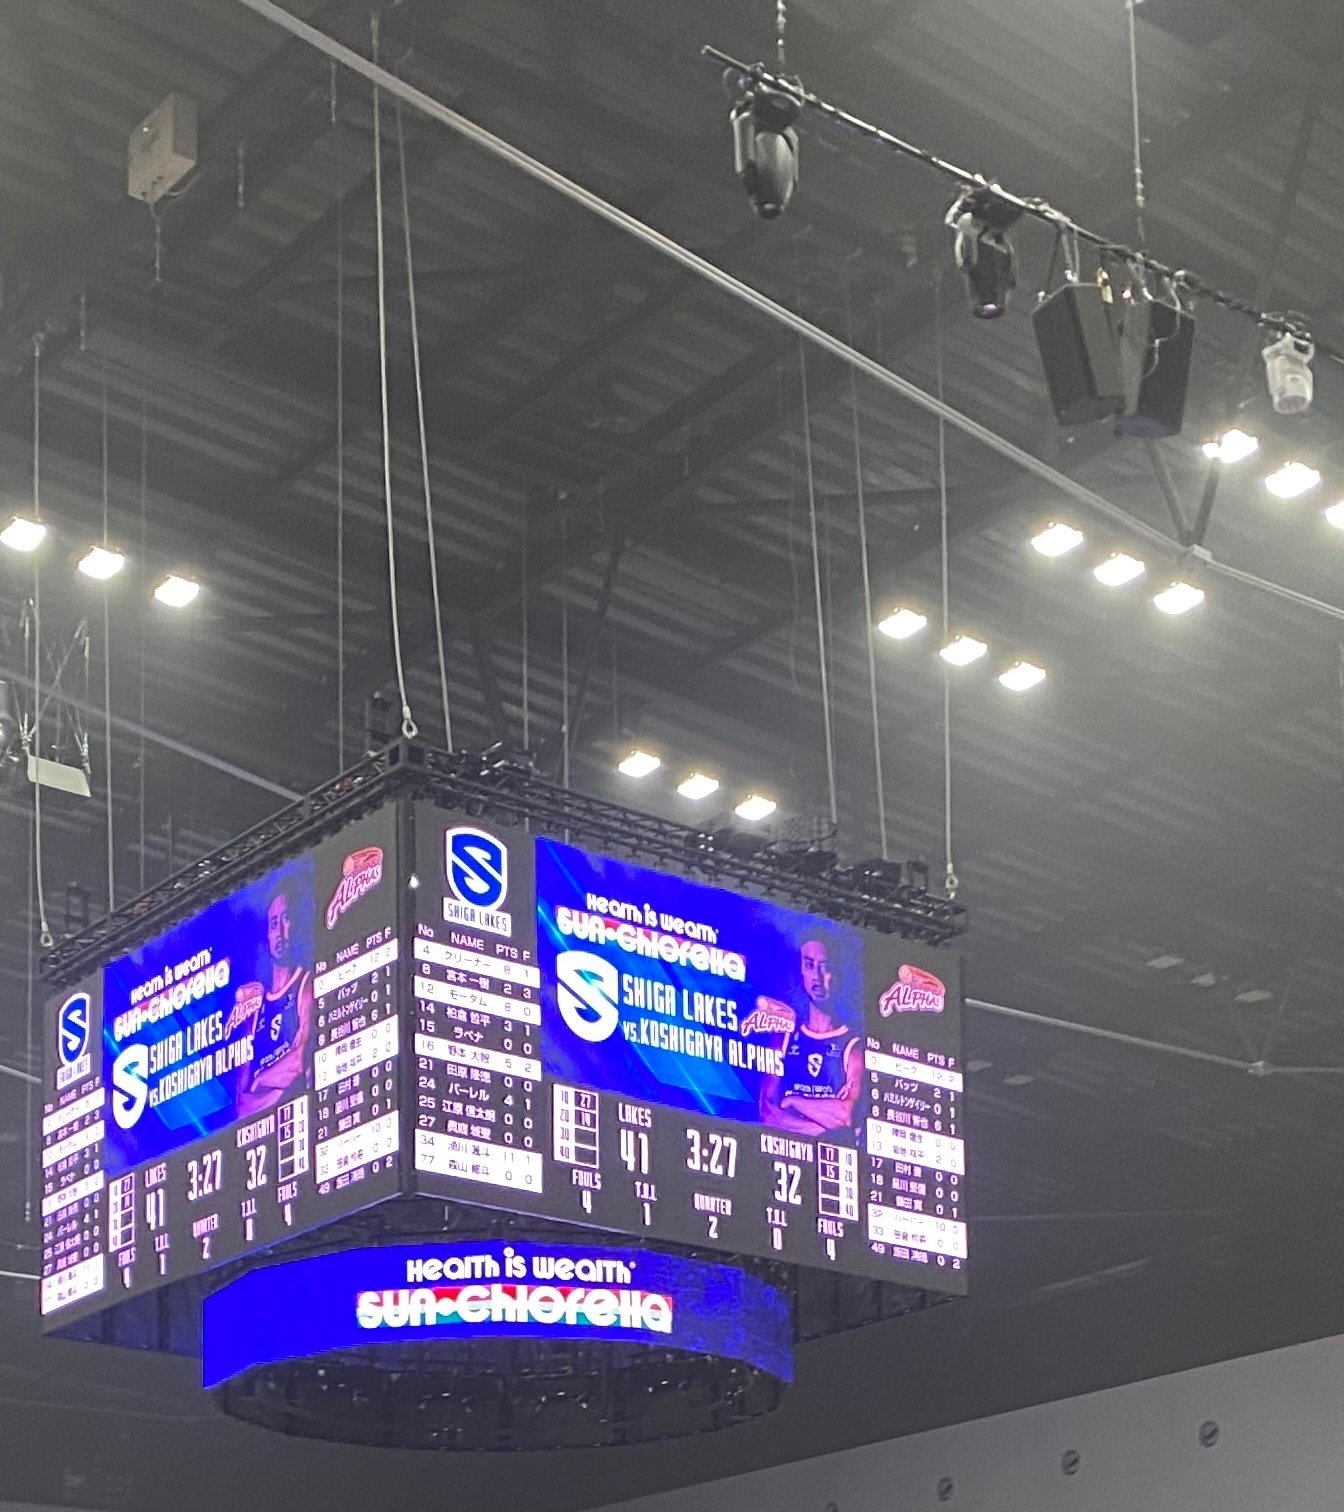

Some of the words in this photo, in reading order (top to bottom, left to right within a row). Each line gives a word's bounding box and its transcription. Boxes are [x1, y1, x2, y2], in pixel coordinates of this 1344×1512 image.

[448, 903, 475, 922] SHIGA
[479, 911, 507, 931] LAKES
[423, 945, 430, 954] 4
[451, 932, 484, 950] NAME
[496, 944, 517, 958] PTS
[421, 981, 434, 993] 12
[450, 990, 487, 1006] モータム
[524, 1007, 531, 1016] 0
[503, 983, 512, 994] 2
[523, 988, 531, 998] 3
[623, 973, 677, 1017] SHIGA
[683, 988, 739, 1032] LAKES
[420, 1000, 435, 1014] 14
[504, 1021, 512, 1031] 3
[525, 1025, 530, 1036] 1
[149, 1030, 183, 1075] SHIGA
[187, 1010, 223, 1056] LAKES
[420, 1019, 435, 1032] 15
[504, 1038, 512, 1050] 0
[523, 1043, 531, 1054] 0
[215, 1034, 254, 1076] ALPHAS
[505, 1059, 512, 1068] 5
[525, 1063, 531, 1072] 2
[728, 1039, 785, 1077] ALPHAS
[892, 1043, 919, 1059] NAME
[927, 1052, 946, 1066] PTS
[418, 1058, 433, 1070] 21
[504, 1076, 513, 1087] 0
[524, 1081, 532, 1092] 0
[418, 1077, 436, 1089] 24
[449, 1083, 489, 1101] バーレル
[504, 1095, 513, 1106] 4
[525, 1099, 530, 1110] 1
[933, 1087, 941, 1099] 2
[418, 1095, 435, 1108] 25
[504, 1113, 513, 1125] 0
[524, 1118, 532, 1129] 0
[580, 1093, 591, 1105] 27
[618, 1102, 652, 1128] LAKES
[934, 1103, 942, 1115] 0
[418, 1115, 435, 1127] 27
[504, 1132, 513, 1143] 0
[524, 1136, 532, 1148] 0
[421, 1135, 434, 1145] 34
[934, 1120, 942, 1132] 6
[620, 1128, 649, 1175] 41
[686, 1128, 737, 1178] 3:27
[760, 1133, 813, 1163] KOSHIGAYA
[187, 1149, 222, 1200] 3:27
[246, 1144, 267, 1190] 32
[421, 1154, 434, 1164] 77
[505, 1171, 512, 1180] 0
[525, 1175, 532, 1184] 0
[572, 1168, 601, 1190] FOULS
[826, 1166, 835, 1179] 15
[871, 1156, 883, 1169] 17
[935, 1171, 943, 1182] 0
[950, 1175, 958, 1185] 0
[773, 1161, 802, 1205] 32
[871, 1173, 884, 1186] 18
[936, 1187, 944, 1199] 0
[951, 1191, 959, 1202] 0
[146, 1188, 164, 1231] 41
[582, 1190, 592, 1214] 4
[643, 1202, 651, 1226] 1
[693, 1192, 732, 1216] QUARTER
[870, 1190, 883, 1203] 21
[936, 1204, 944, 1216] 0
[708, 1215, 719, 1239] 2
[772, 1227, 783, 1250] 0
[818, 1218, 844, 1238] FOULS
[202, 1237, 211, 1260] 2
[937, 1255, 945, 1267] 0
[952, 1259, 961, 1270] 2
